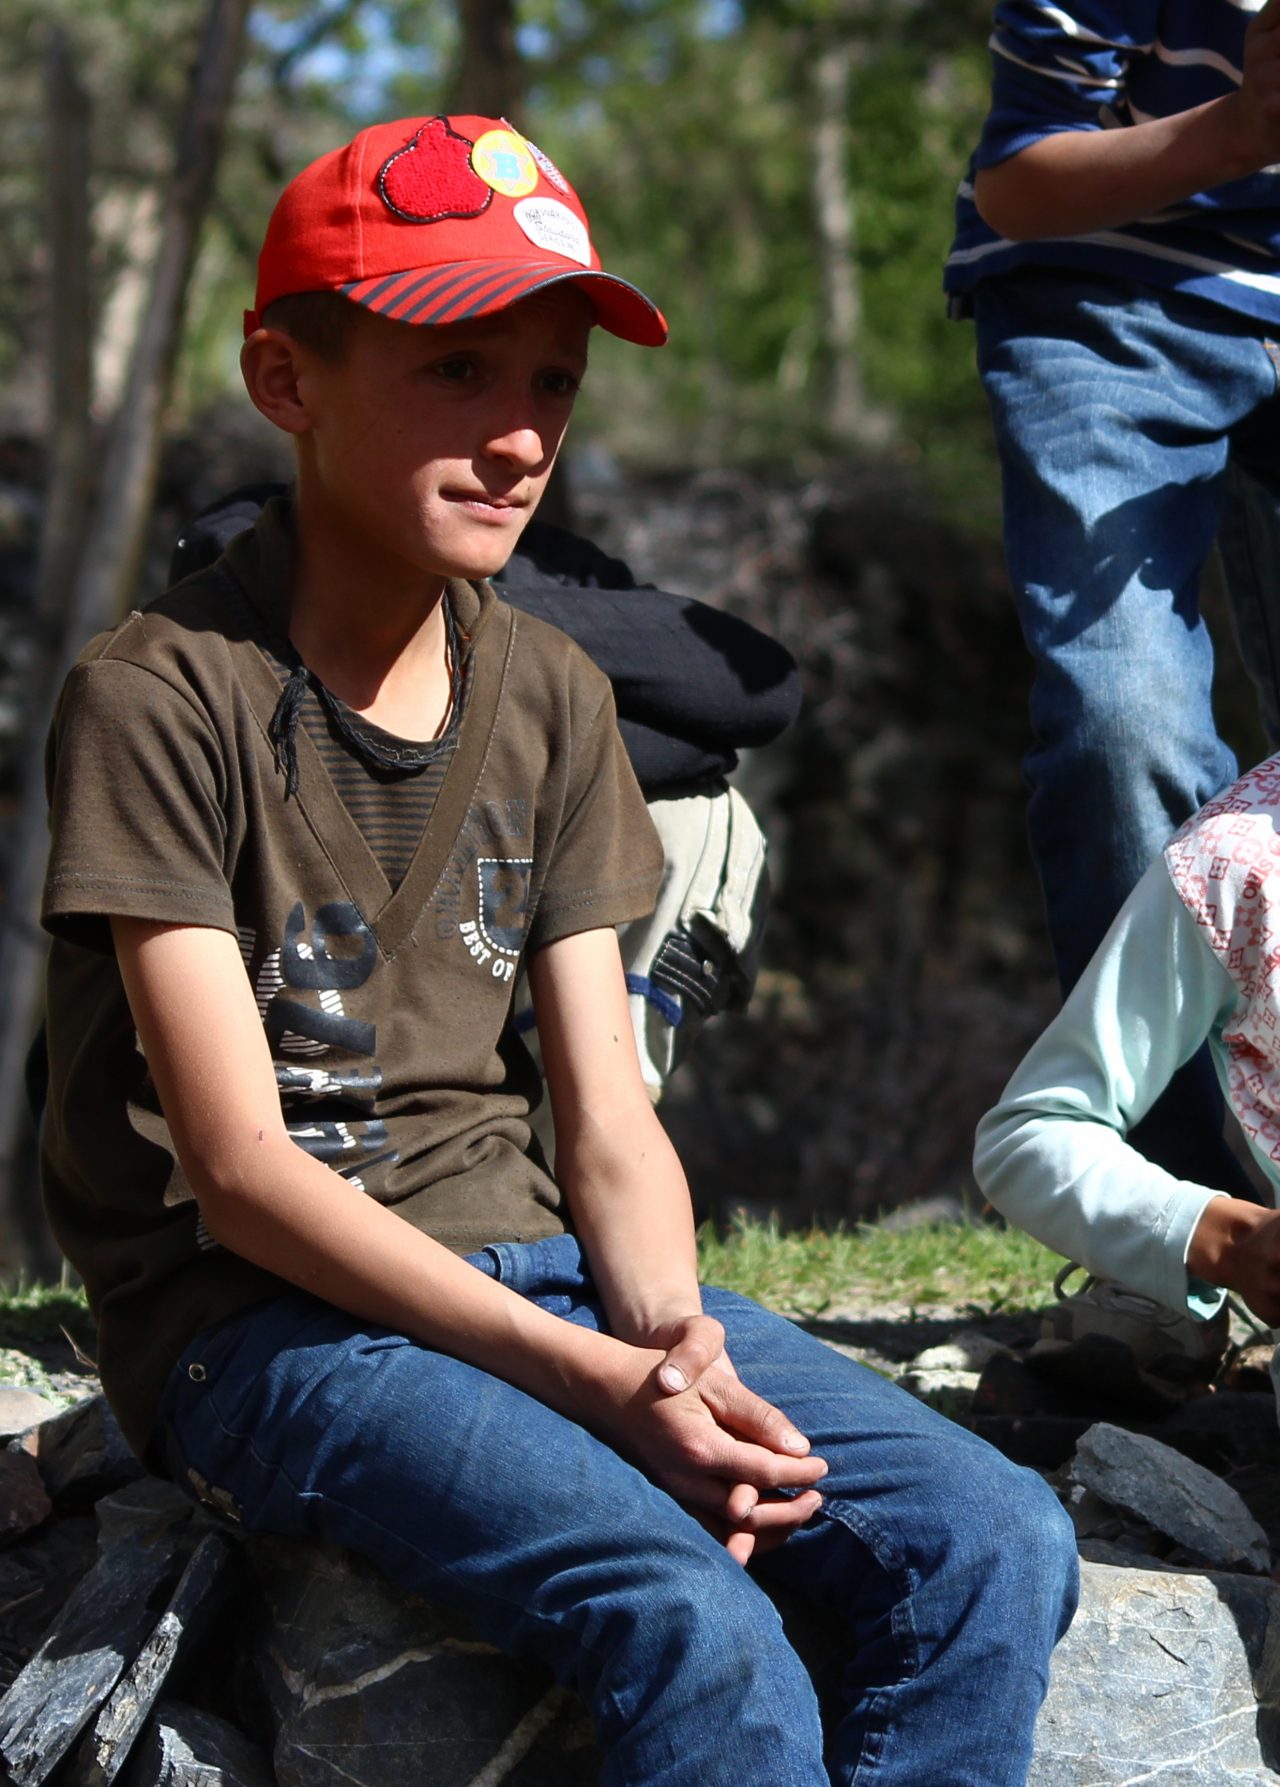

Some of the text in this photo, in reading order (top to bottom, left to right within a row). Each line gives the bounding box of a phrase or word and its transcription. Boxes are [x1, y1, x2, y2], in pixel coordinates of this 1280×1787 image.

[492, 151, 520, 180] B
[460, 920, 514, 981] BEST OF
